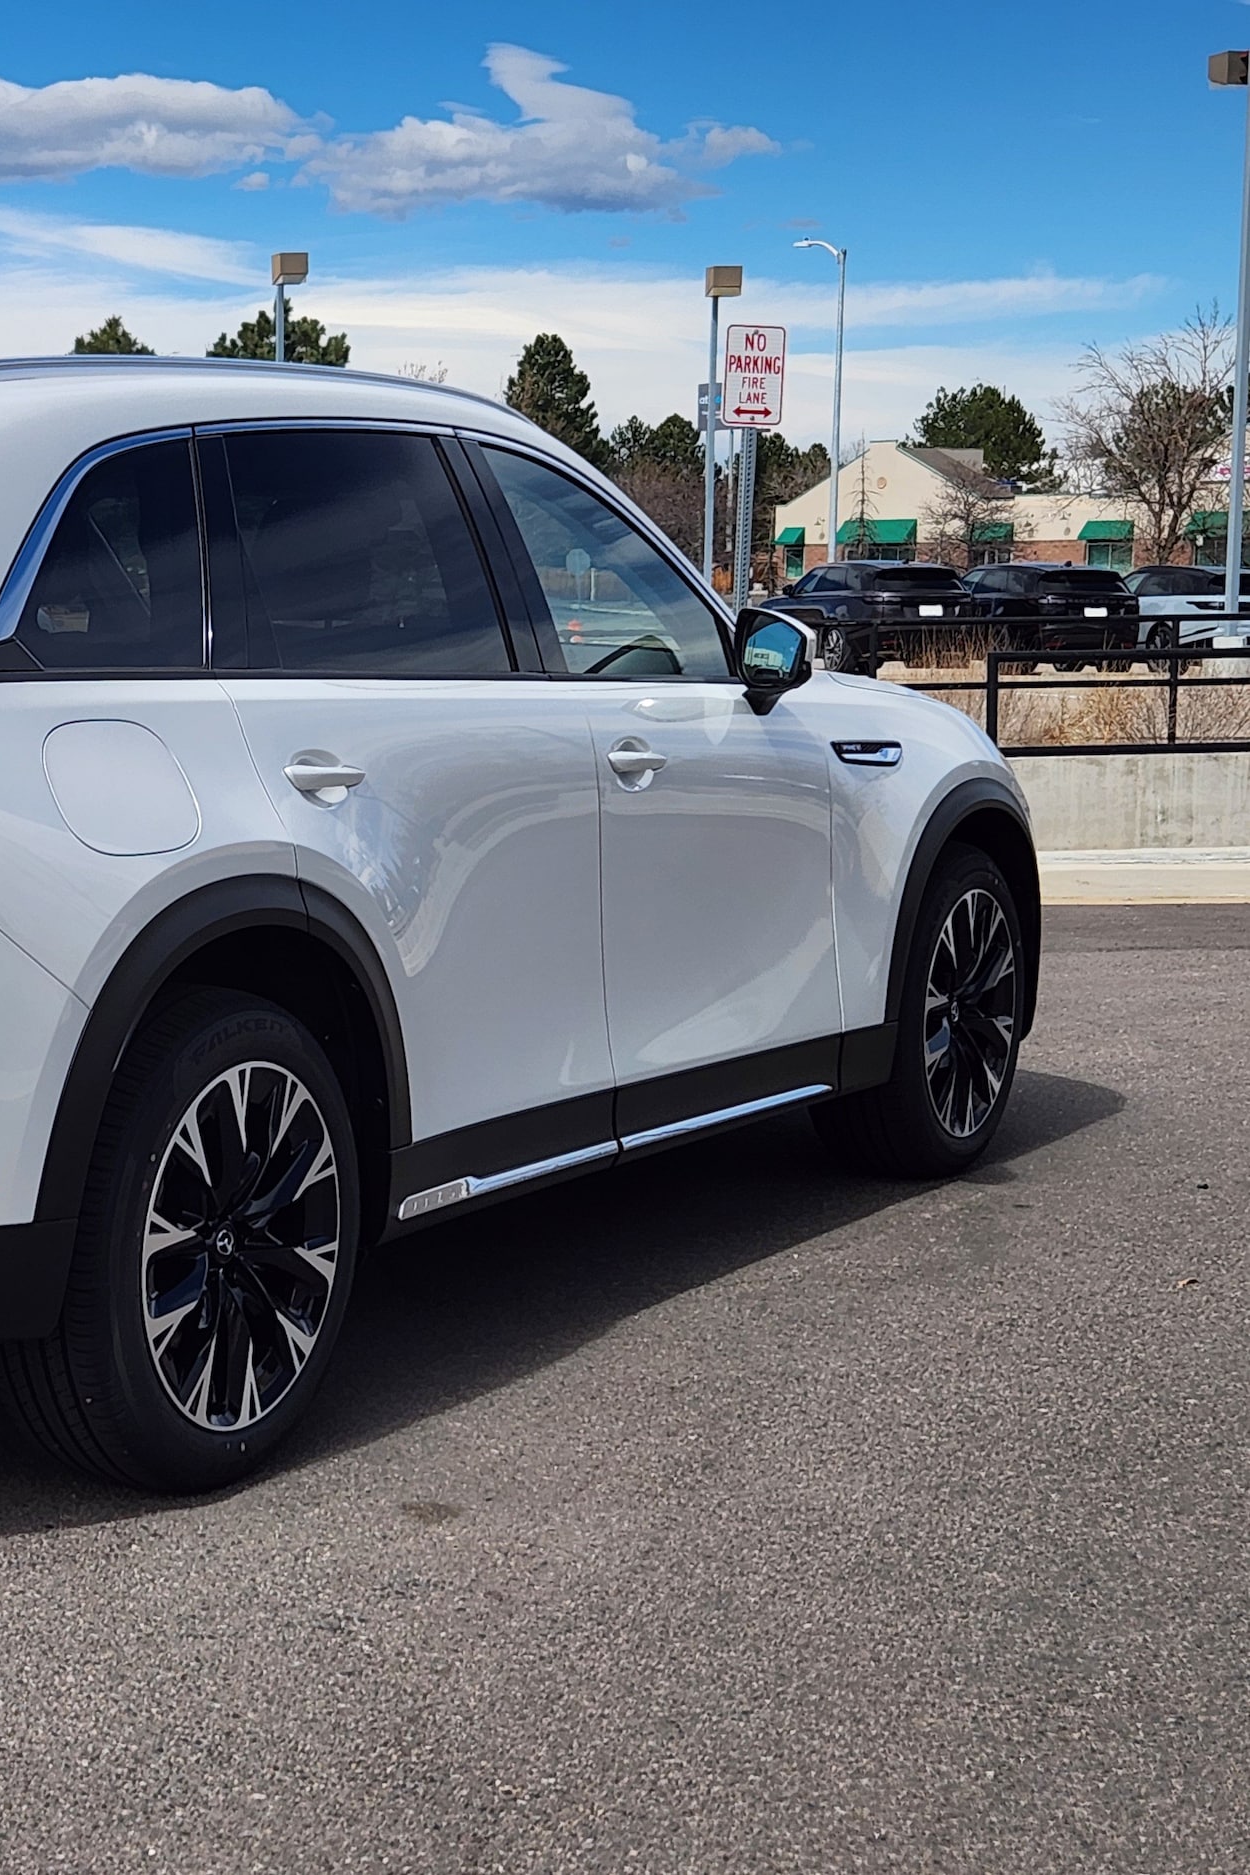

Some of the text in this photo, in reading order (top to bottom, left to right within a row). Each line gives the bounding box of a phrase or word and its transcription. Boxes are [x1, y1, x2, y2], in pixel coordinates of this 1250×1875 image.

[745, 333, 767, 352] NO
[728, 354, 782, 375] PARKING
[742, 376, 767, 390] FIRE
[738, 391, 767, 405] LANE
